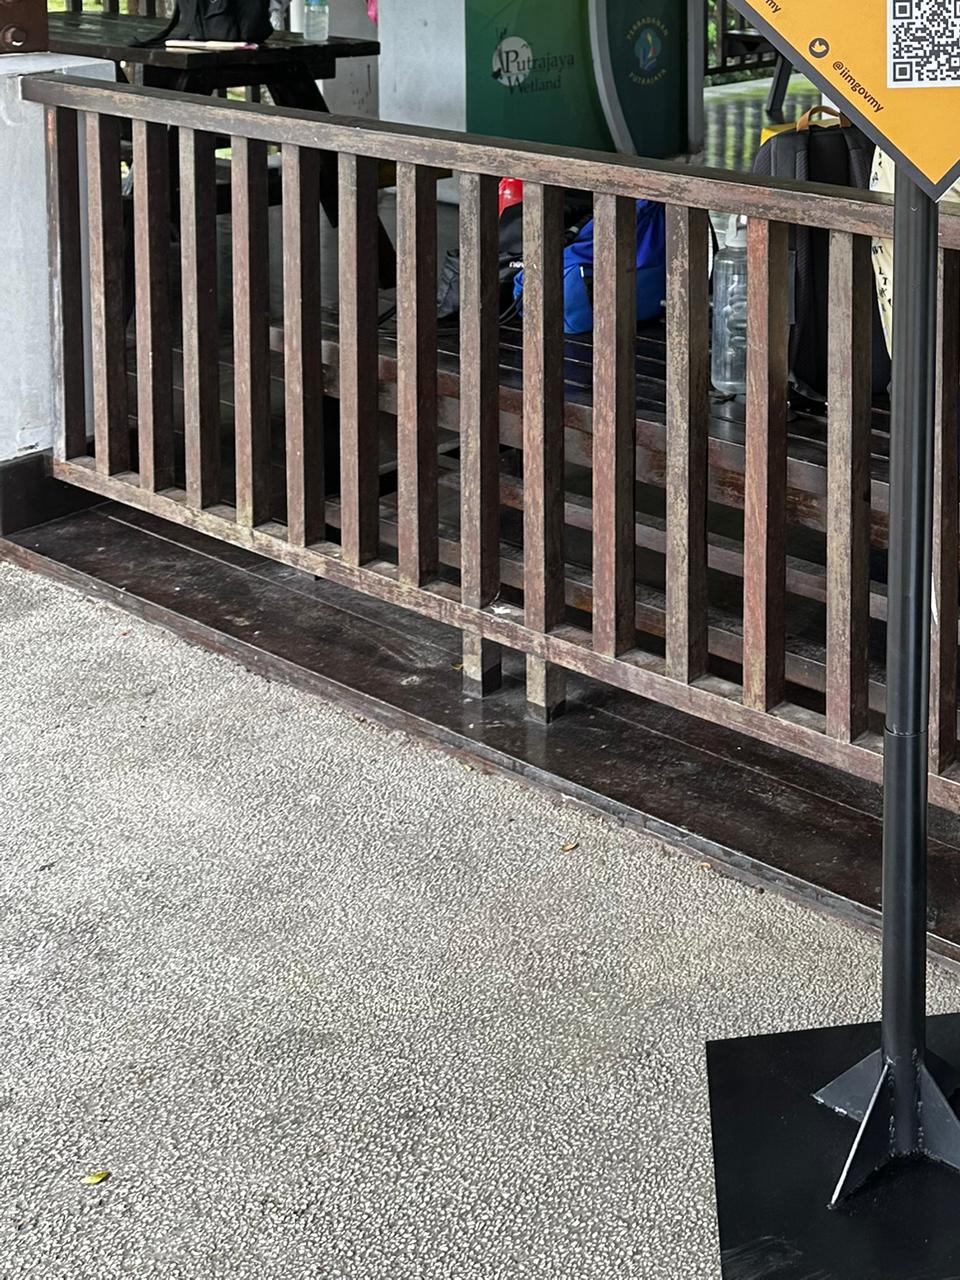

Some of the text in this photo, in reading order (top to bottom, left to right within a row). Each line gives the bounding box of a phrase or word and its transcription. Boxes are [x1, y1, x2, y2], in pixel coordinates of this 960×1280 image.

[504, 50, 575, 73] Putrajaya
[507, 75, 562, 95] Wetland
[832, 60, 884, 114] @iimgovmy
